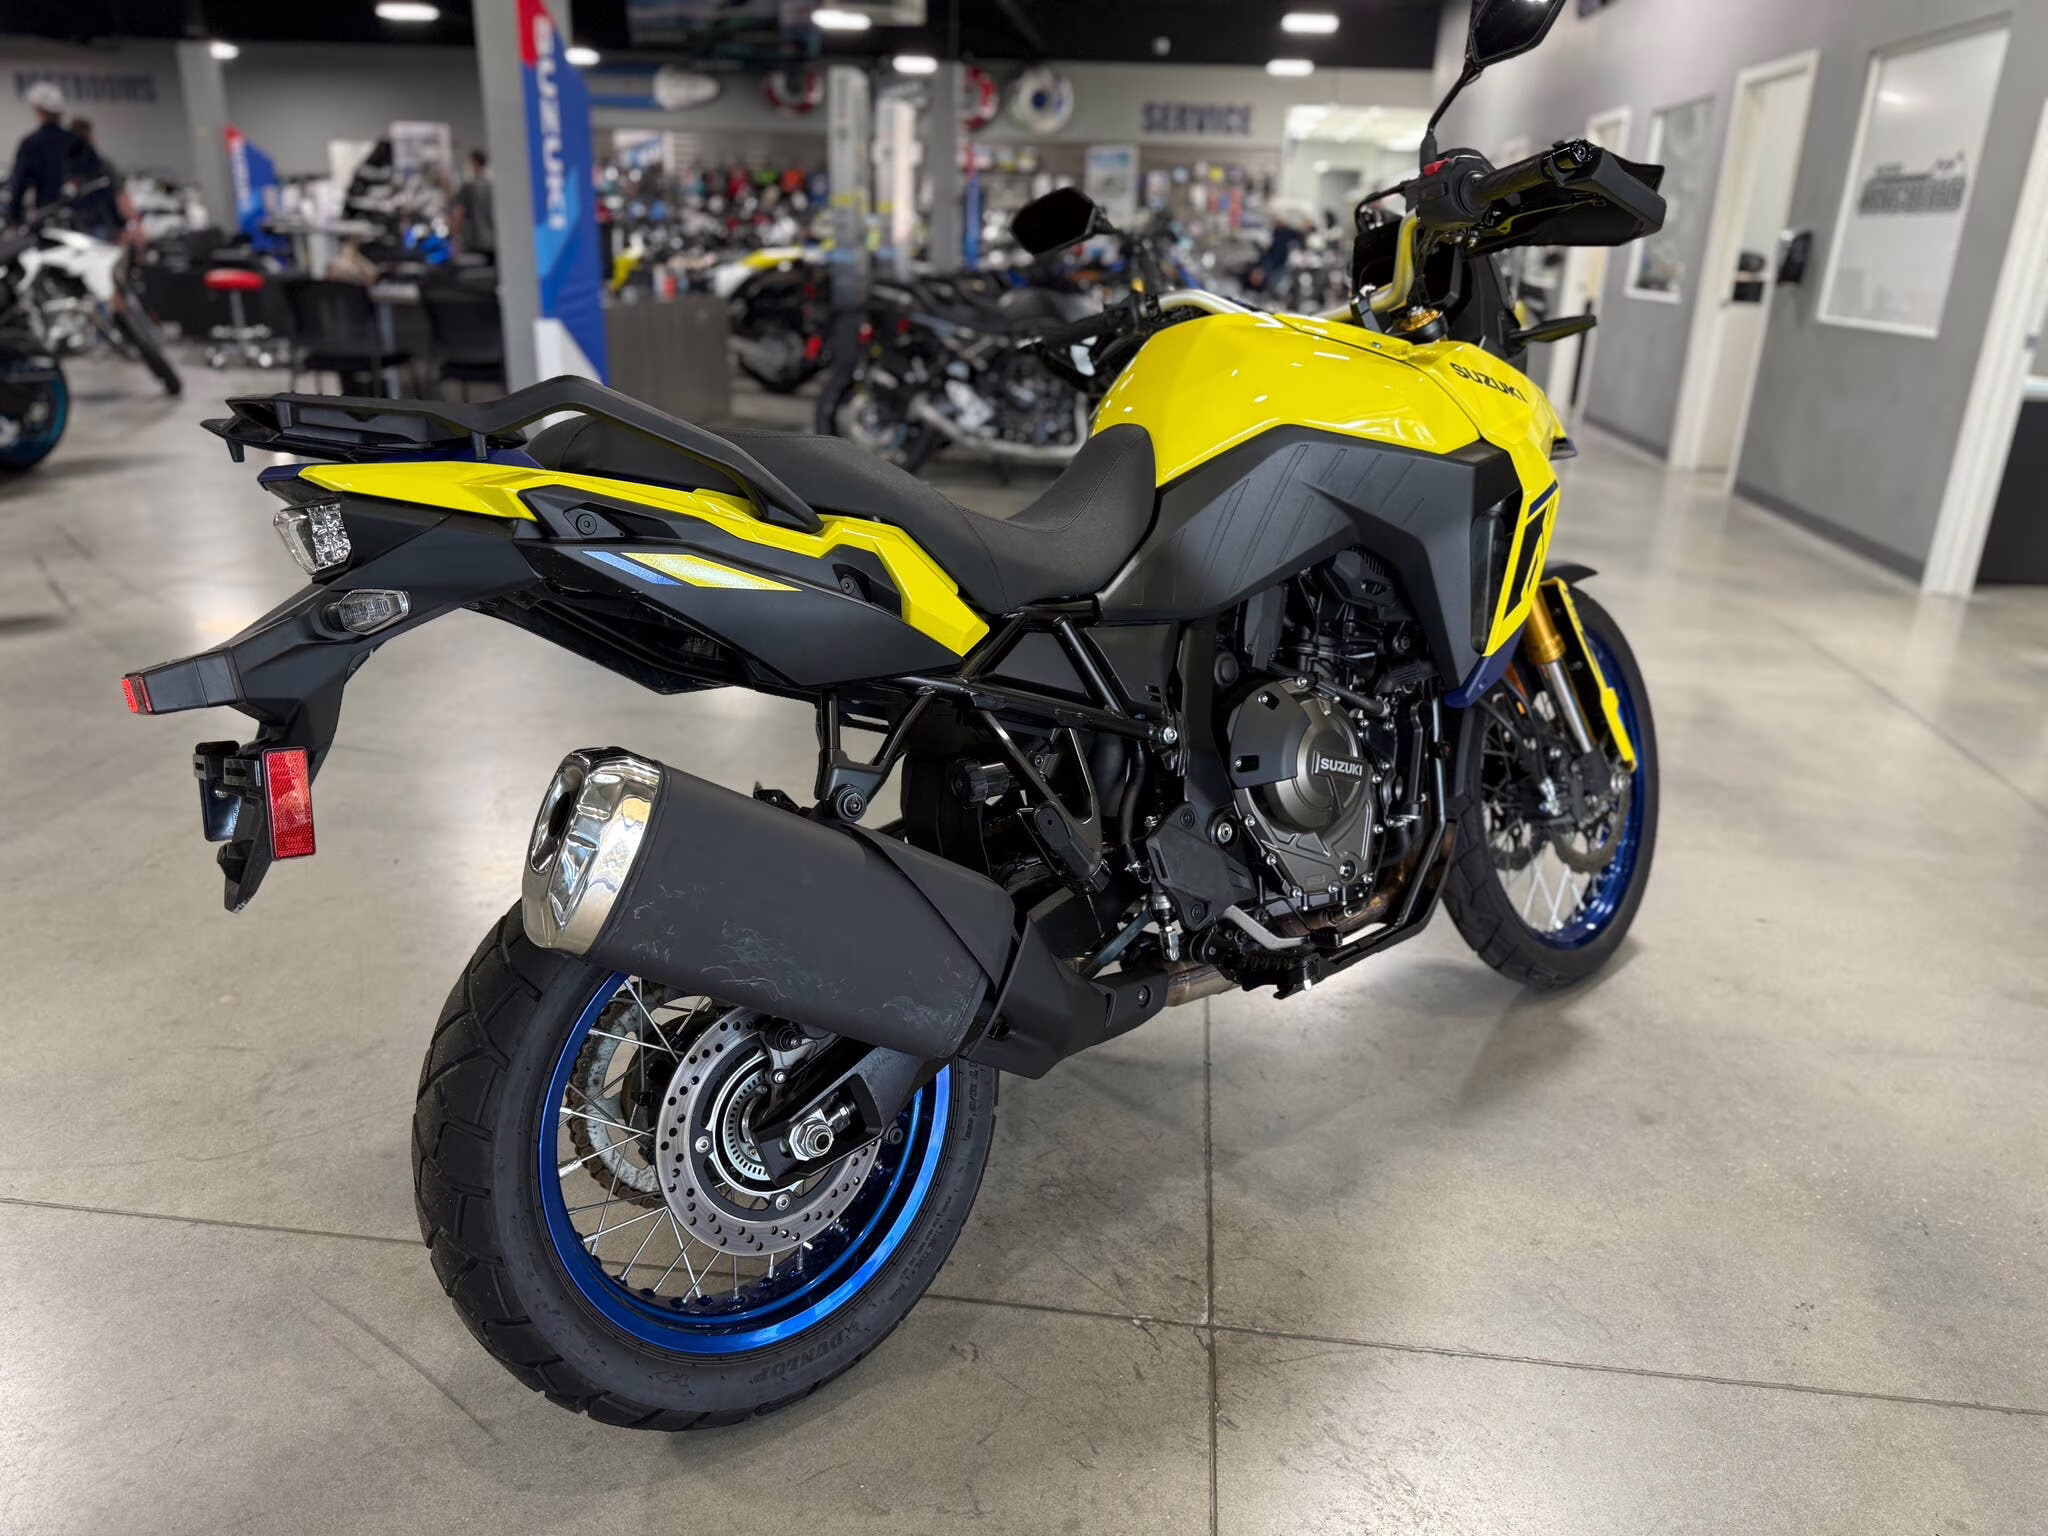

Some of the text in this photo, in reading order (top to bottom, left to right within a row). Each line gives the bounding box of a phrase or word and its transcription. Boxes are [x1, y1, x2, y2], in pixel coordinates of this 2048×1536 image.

[532, 13, 567, 231] SUZUKI
[1143, 101, 1252, 135] SERVICE
[1449, 362, 1529, 404] SUZUKI
[1319, 757, 1363, 777] SUZUKI
[752, 1328, 845, 1383] DUNLOP
